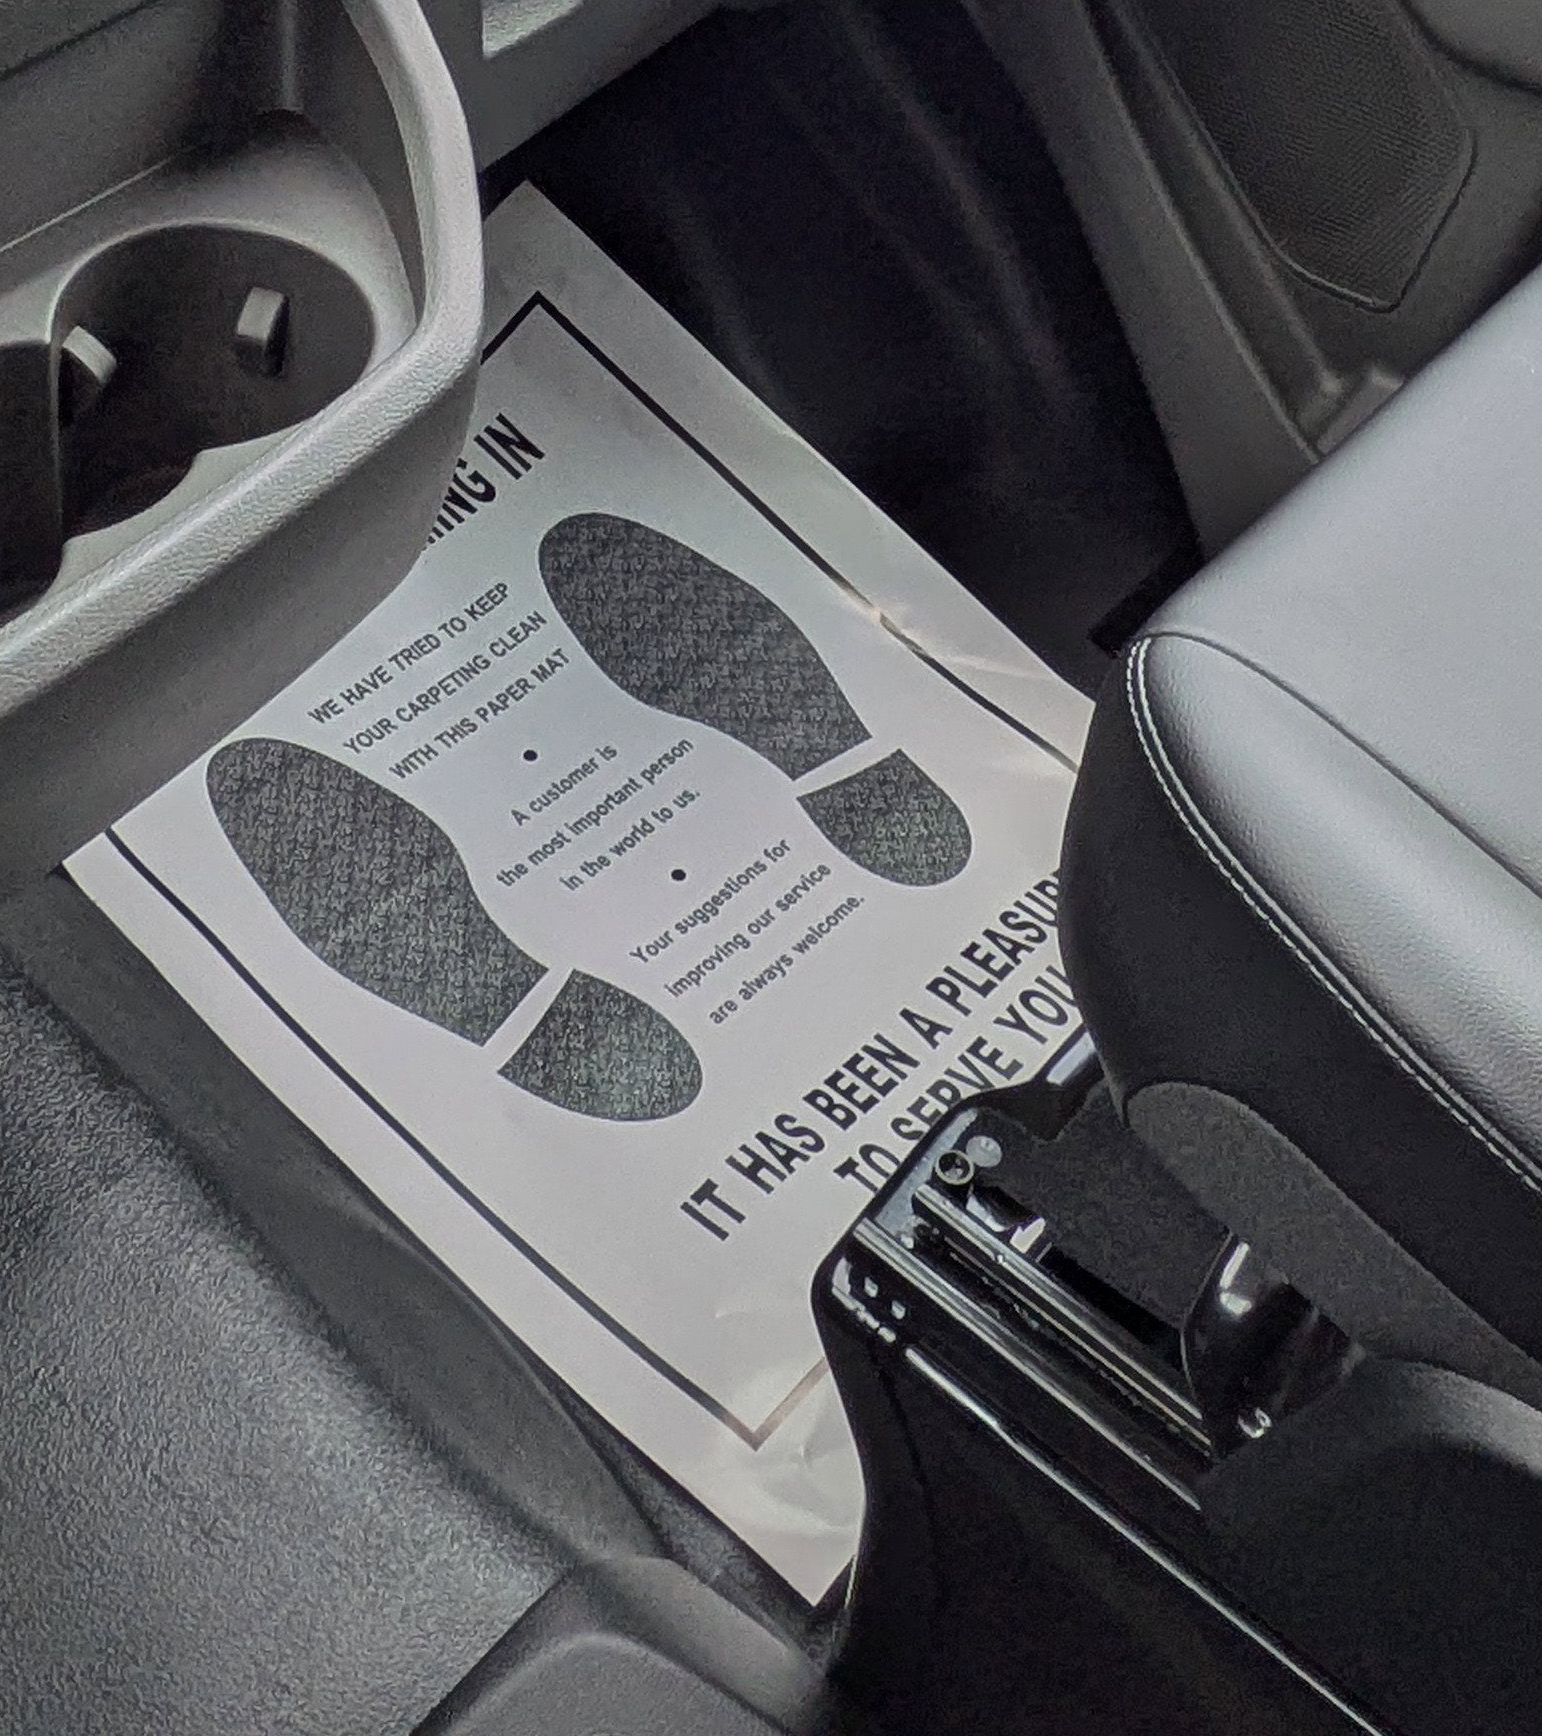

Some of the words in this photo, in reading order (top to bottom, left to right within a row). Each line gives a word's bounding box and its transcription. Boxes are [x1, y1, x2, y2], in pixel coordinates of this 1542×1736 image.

[474, 413, 546, 480] IN
[307, 697, 345, 725] WE
[339, 665, 393, 707] HAVE
[389, 634, 441, 672] TRIED
[438, 617, 468, 639] TO
[464, 582, 509, 622] KEEP
[342, 718, 398, 755] YOUR
[396, 654, 492, 723] CARPETING
[489, 610, 548, 657] CLEAN
[388, 743, 439, 780] WITH
[434, 717, 479, 750] THIS
[474, 677, 537, 724] PAPER
[530, 648, 570, 683] MAT
[495, 862, 530, 887] the
[528, 830, 573, 866] most
[564, 777, 643, 837] important
[640, 738, 694, 787] person
[510, 809, 532, 827] A
[528, 757, 600, 813] customer
[595, 745, 618, 762] is
[559, 874, 585, 892] in
[579, 855, 612, 878] the
[609, 817, 655, 856] world
[651, 806, 674, 824] to
[673, 789, 701, 809] us.
[629, 929, 675, 964] Your
[674, 858, 767, 935] suggestions
[763, 838, 791, 863] for
[664, 932, 751, 999] improving
[747, 907, 776, 935] our
[774, 864, 832, 912] service
[709, 999, 739, 1025] are
[738, 954, 794, 1001] always
[790, 896, 865, 955] welcome.
[925, 869, 1060, 1017] PLEASUR
[802, 1032, 921, 1131] BEEN
[898, 1006, 954, 1050] A
[724, 1113, 827, 1194] HAS
[833, 1143, 903, 1194] TO
[890, 1035, 1025, 1141] SERVE
[679, 1178, 746, 1241] IT
